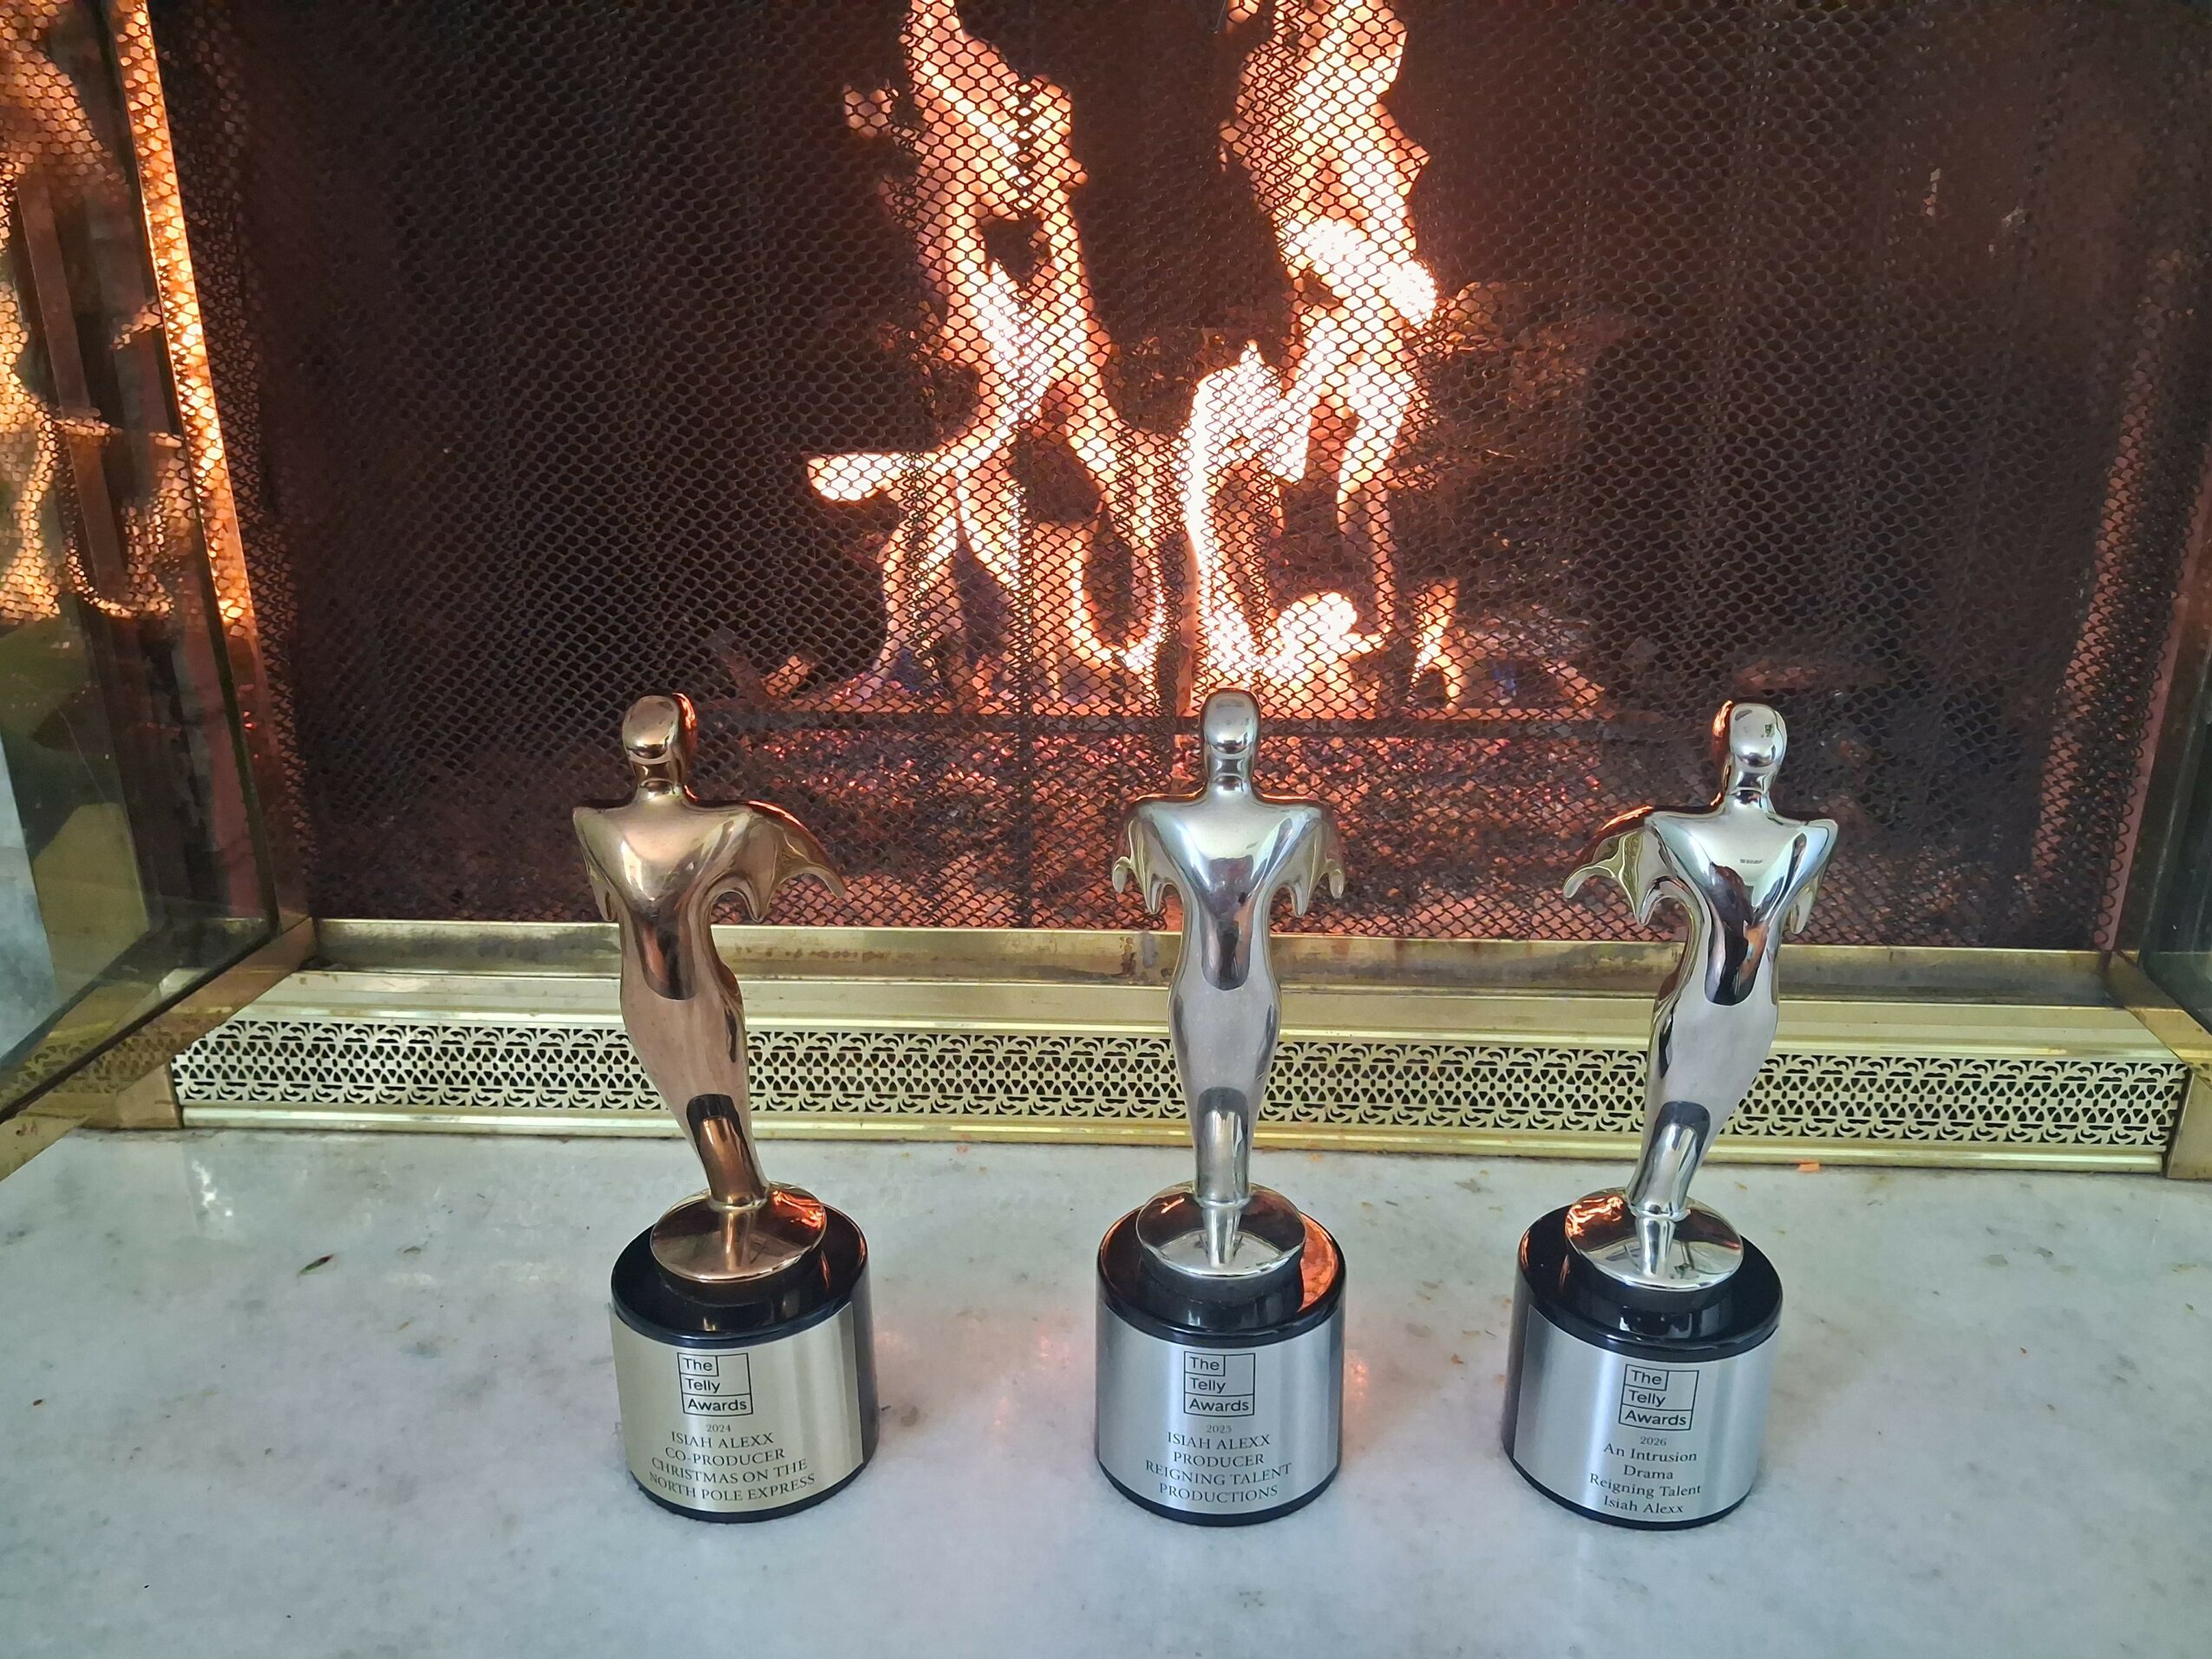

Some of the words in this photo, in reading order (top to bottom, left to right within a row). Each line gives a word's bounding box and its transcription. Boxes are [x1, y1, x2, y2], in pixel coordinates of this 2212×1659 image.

[684, 1357, 713, 1371] The
[1190, 1357, 1220, 1370] The
[1631, 1370, 1661, 1385] The
[685, 1378, 720, 1394] Telly
[1190, 1378, 1226, 1394] Telly
[688, 1399, 747, 1411] Awards
[1189, 1399, 1249, 1412] Awards
[1629, 1389, 1666, 1407] Telly
[1625, 1410, 1686, 1426] Awards
[671, 1432, 712, 1447] ISIAH
[718, 1433, 775, 1448] ALEXX
[1168, 1432, 1210, 1449] ISIAH
[1217, 1434, 1271, 1450] ALEXX
[1640, 1436, 1666, 1446] 2026
[665, 1447, 785, 1466] CO-PRODUCER
[1174, 1452, 1264, 1467] PRODUCER
[1604, 1443, 1625, 1457] An
[1631, 1448, 1697, 1462] Intrusion
[652, 1458, 737, 1484] CHRISTMAS
[743, 1470, 769, 1483] ON
[774, 1459, 808, 1477] THE
[1146, 1460, 1226, 1486] REIGNING
[1229, 1463, 1292, 1485] TALENT
[1624, 1465, 1673, 1479] Drama
[650, 1472, 696, 1497] NORTH
[702, 1490, 743, 1501] POLE
[748, 1473, 815, 1499] EXPRESS
[1160, 1483, 1278, 1503] PRODUCTIONS
[1590, 1473, 1654, 1499] Reigning
[1659, 1485, 1701, 1497] Talent
[1604, 1496, 1638, 1512] Isiah
[1643, 1503, 1684, 1513] Alexx
